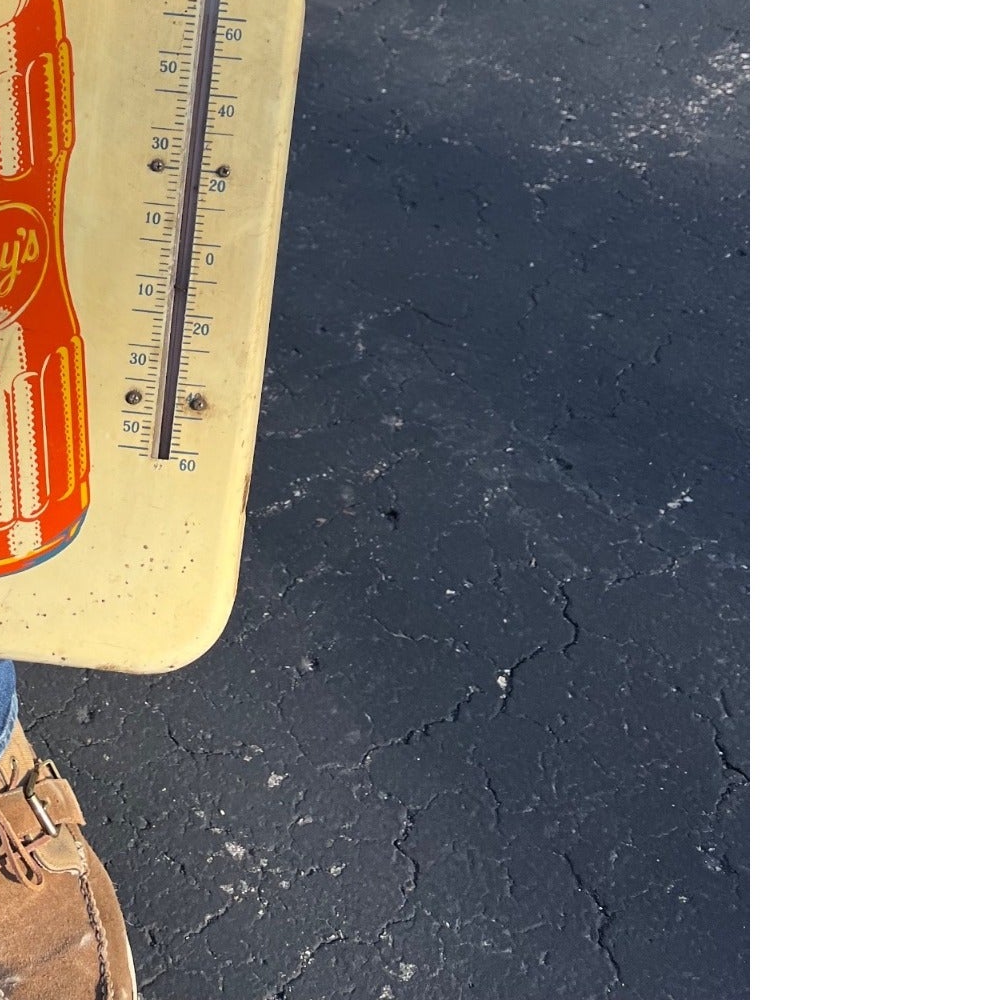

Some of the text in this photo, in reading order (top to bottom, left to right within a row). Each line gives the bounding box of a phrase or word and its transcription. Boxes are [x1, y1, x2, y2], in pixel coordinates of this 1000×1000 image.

[225, 28, 242, 41] 60
[159, 60, 177, 74] 50
[218, 104, 235, 118] 40
[152, 137, 169, 150] 30
[208, 179, 226, 193] 20
[145, 212, 161, 225] 10
[205, 252, 214, 266] 0
[138, 283, 154, 297] 10
[192, 323, 210, 336] 20
[129, 352, 147, 366] 30
[122, 420, 140, 433] 50
[179, 459, 196, 472] 60
